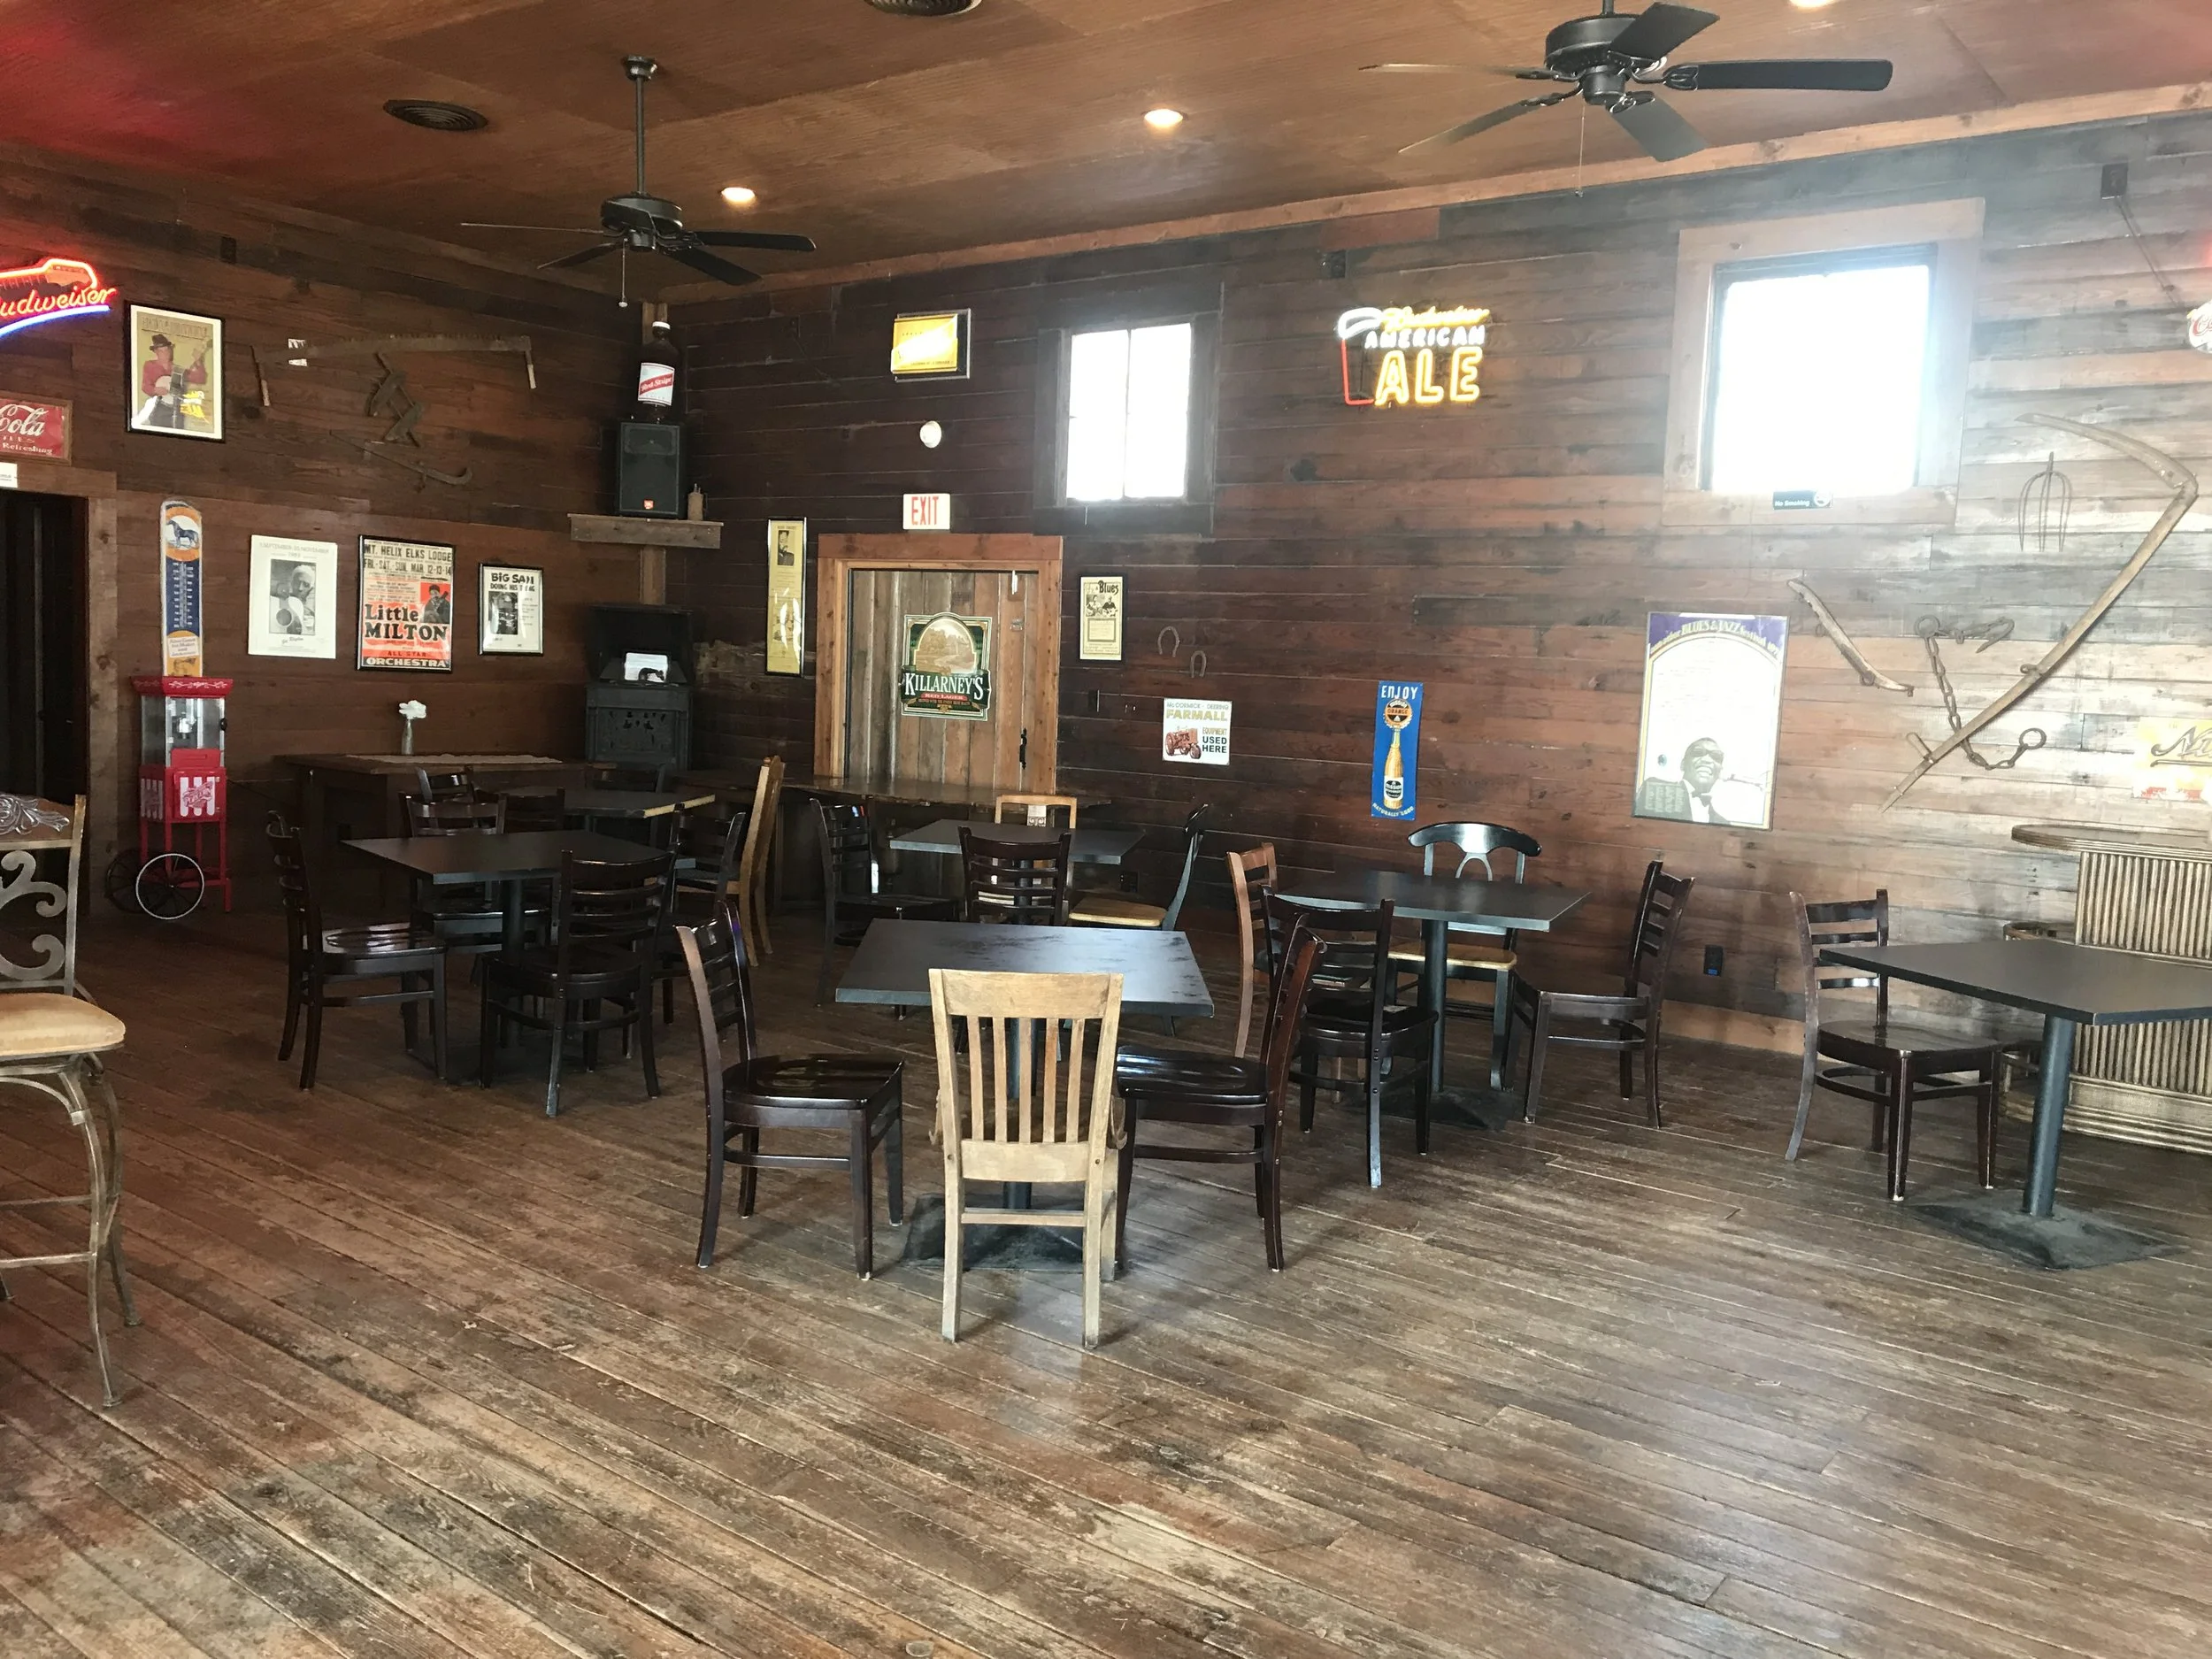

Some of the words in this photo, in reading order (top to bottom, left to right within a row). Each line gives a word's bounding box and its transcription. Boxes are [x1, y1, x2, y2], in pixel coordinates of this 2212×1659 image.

[0, 288, 117, 316] udweiser
[1364, 325, 1486, 349] AMERICAN
[1374, 346, 1483, 406] ALE
[911, 496, 939, 525] EXIT
[380, 545, 403, 557] HELIX
[406, 548, 425, 559] ELKS
[428, 550, 452, 562] LODGE
[1098, 580, 1119, 595] Blues
[365, 603, 419, 621] Little
[365, 622, 447, 641] MILTON
[366, 657, 446, 667] ORCHESTRA
[1381, 685, 1418, 700] ENJOY
[1166, 709, 1227, 721] FARMALL
[1202, 736, 1227, 745] USED
[1202, 745, 1227, 754] HERE
